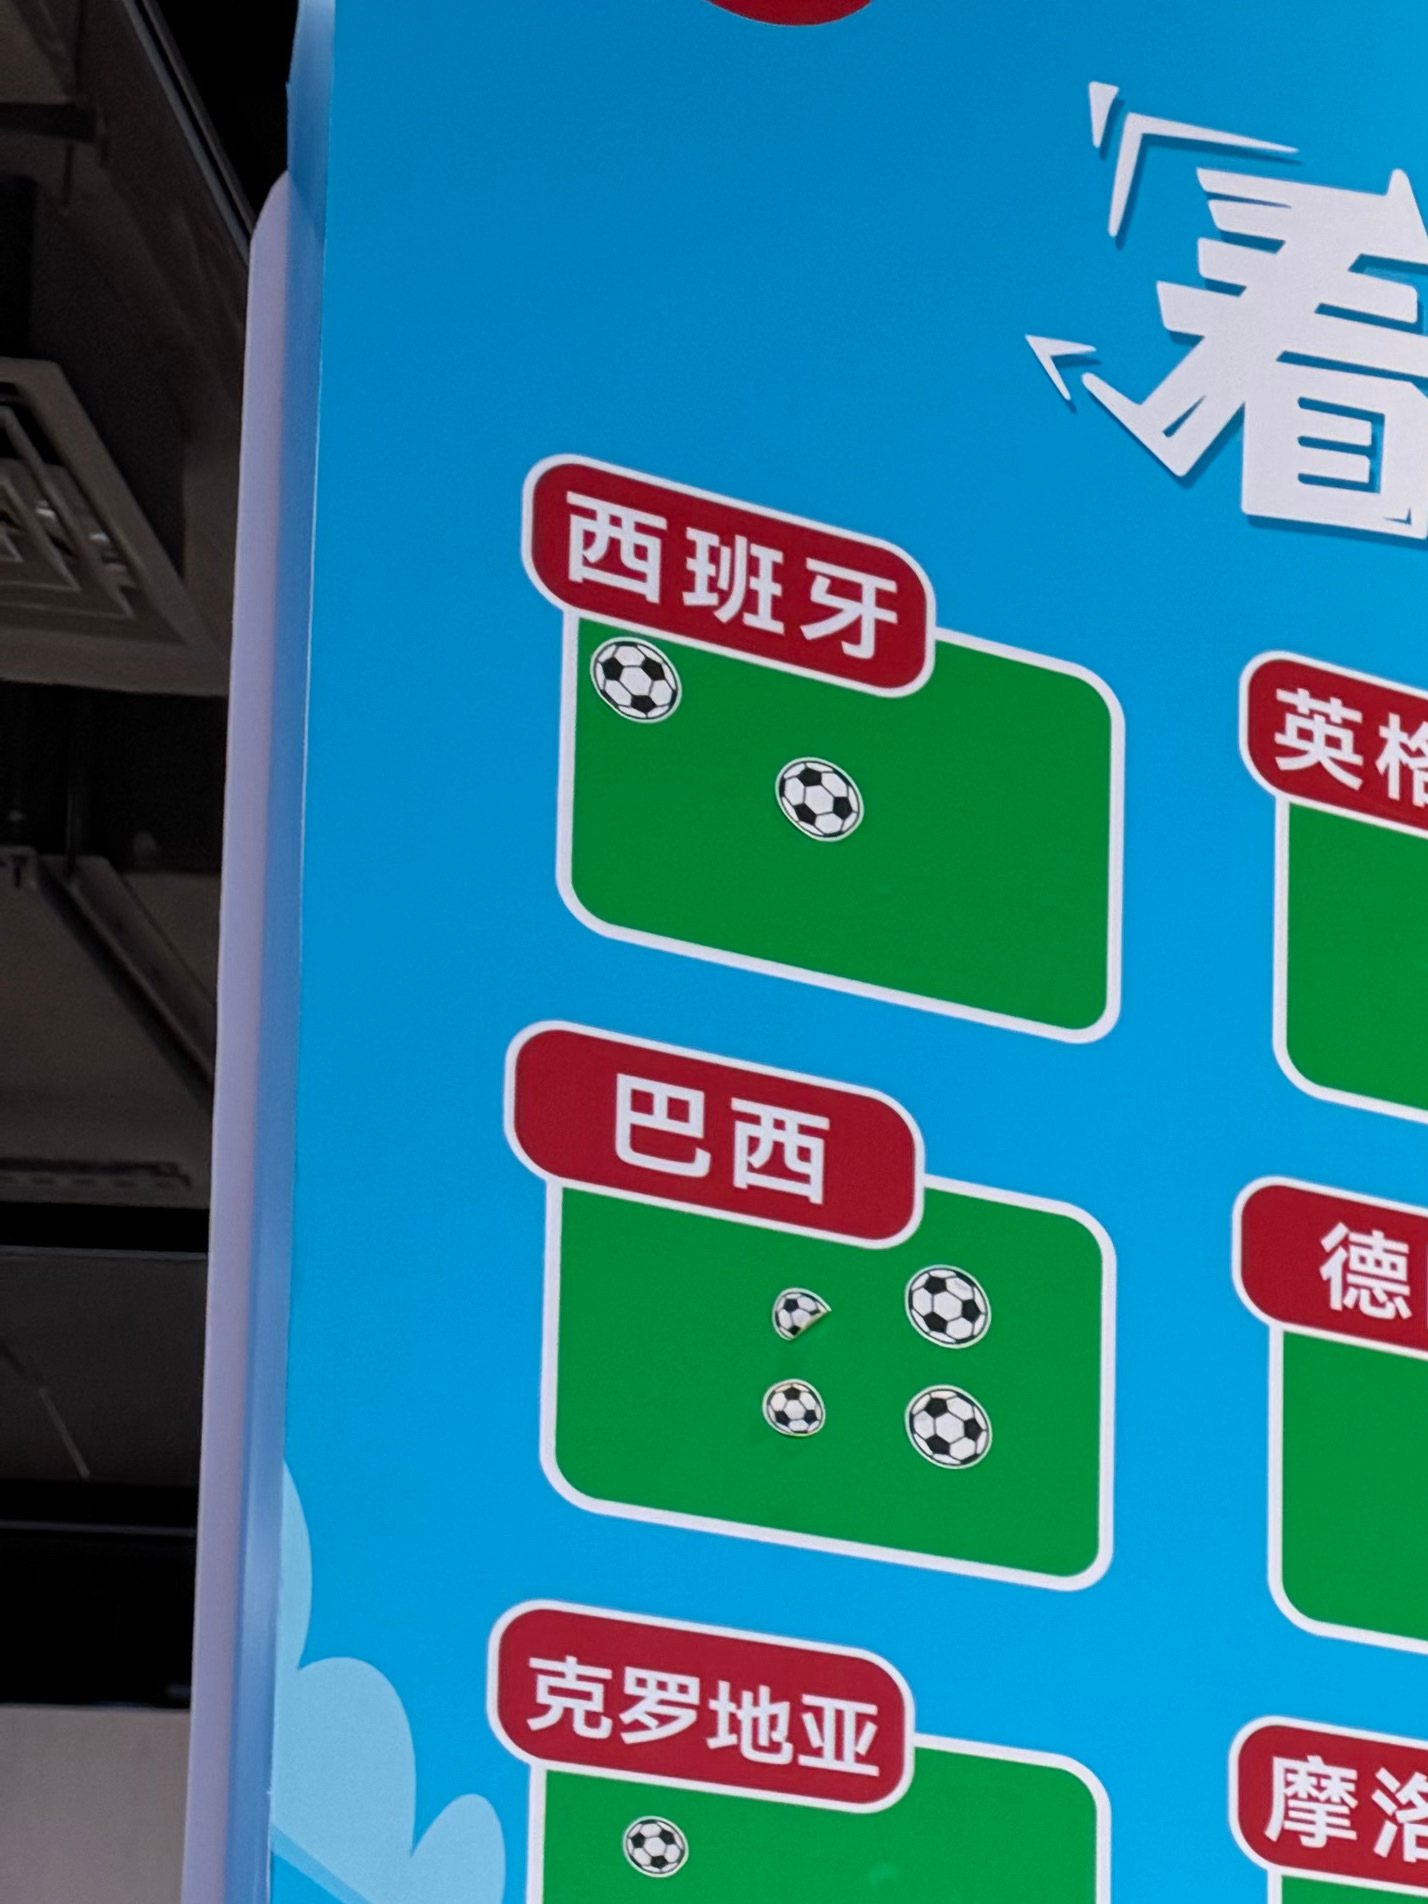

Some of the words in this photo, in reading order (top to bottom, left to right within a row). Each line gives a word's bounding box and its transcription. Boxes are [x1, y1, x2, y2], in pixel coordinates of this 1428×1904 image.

[567, 492, 897, 658] 西班牙
[616, 1074, 829, 1204] 巴西
[527, 1656, 879, 1776] 克罗地亚
